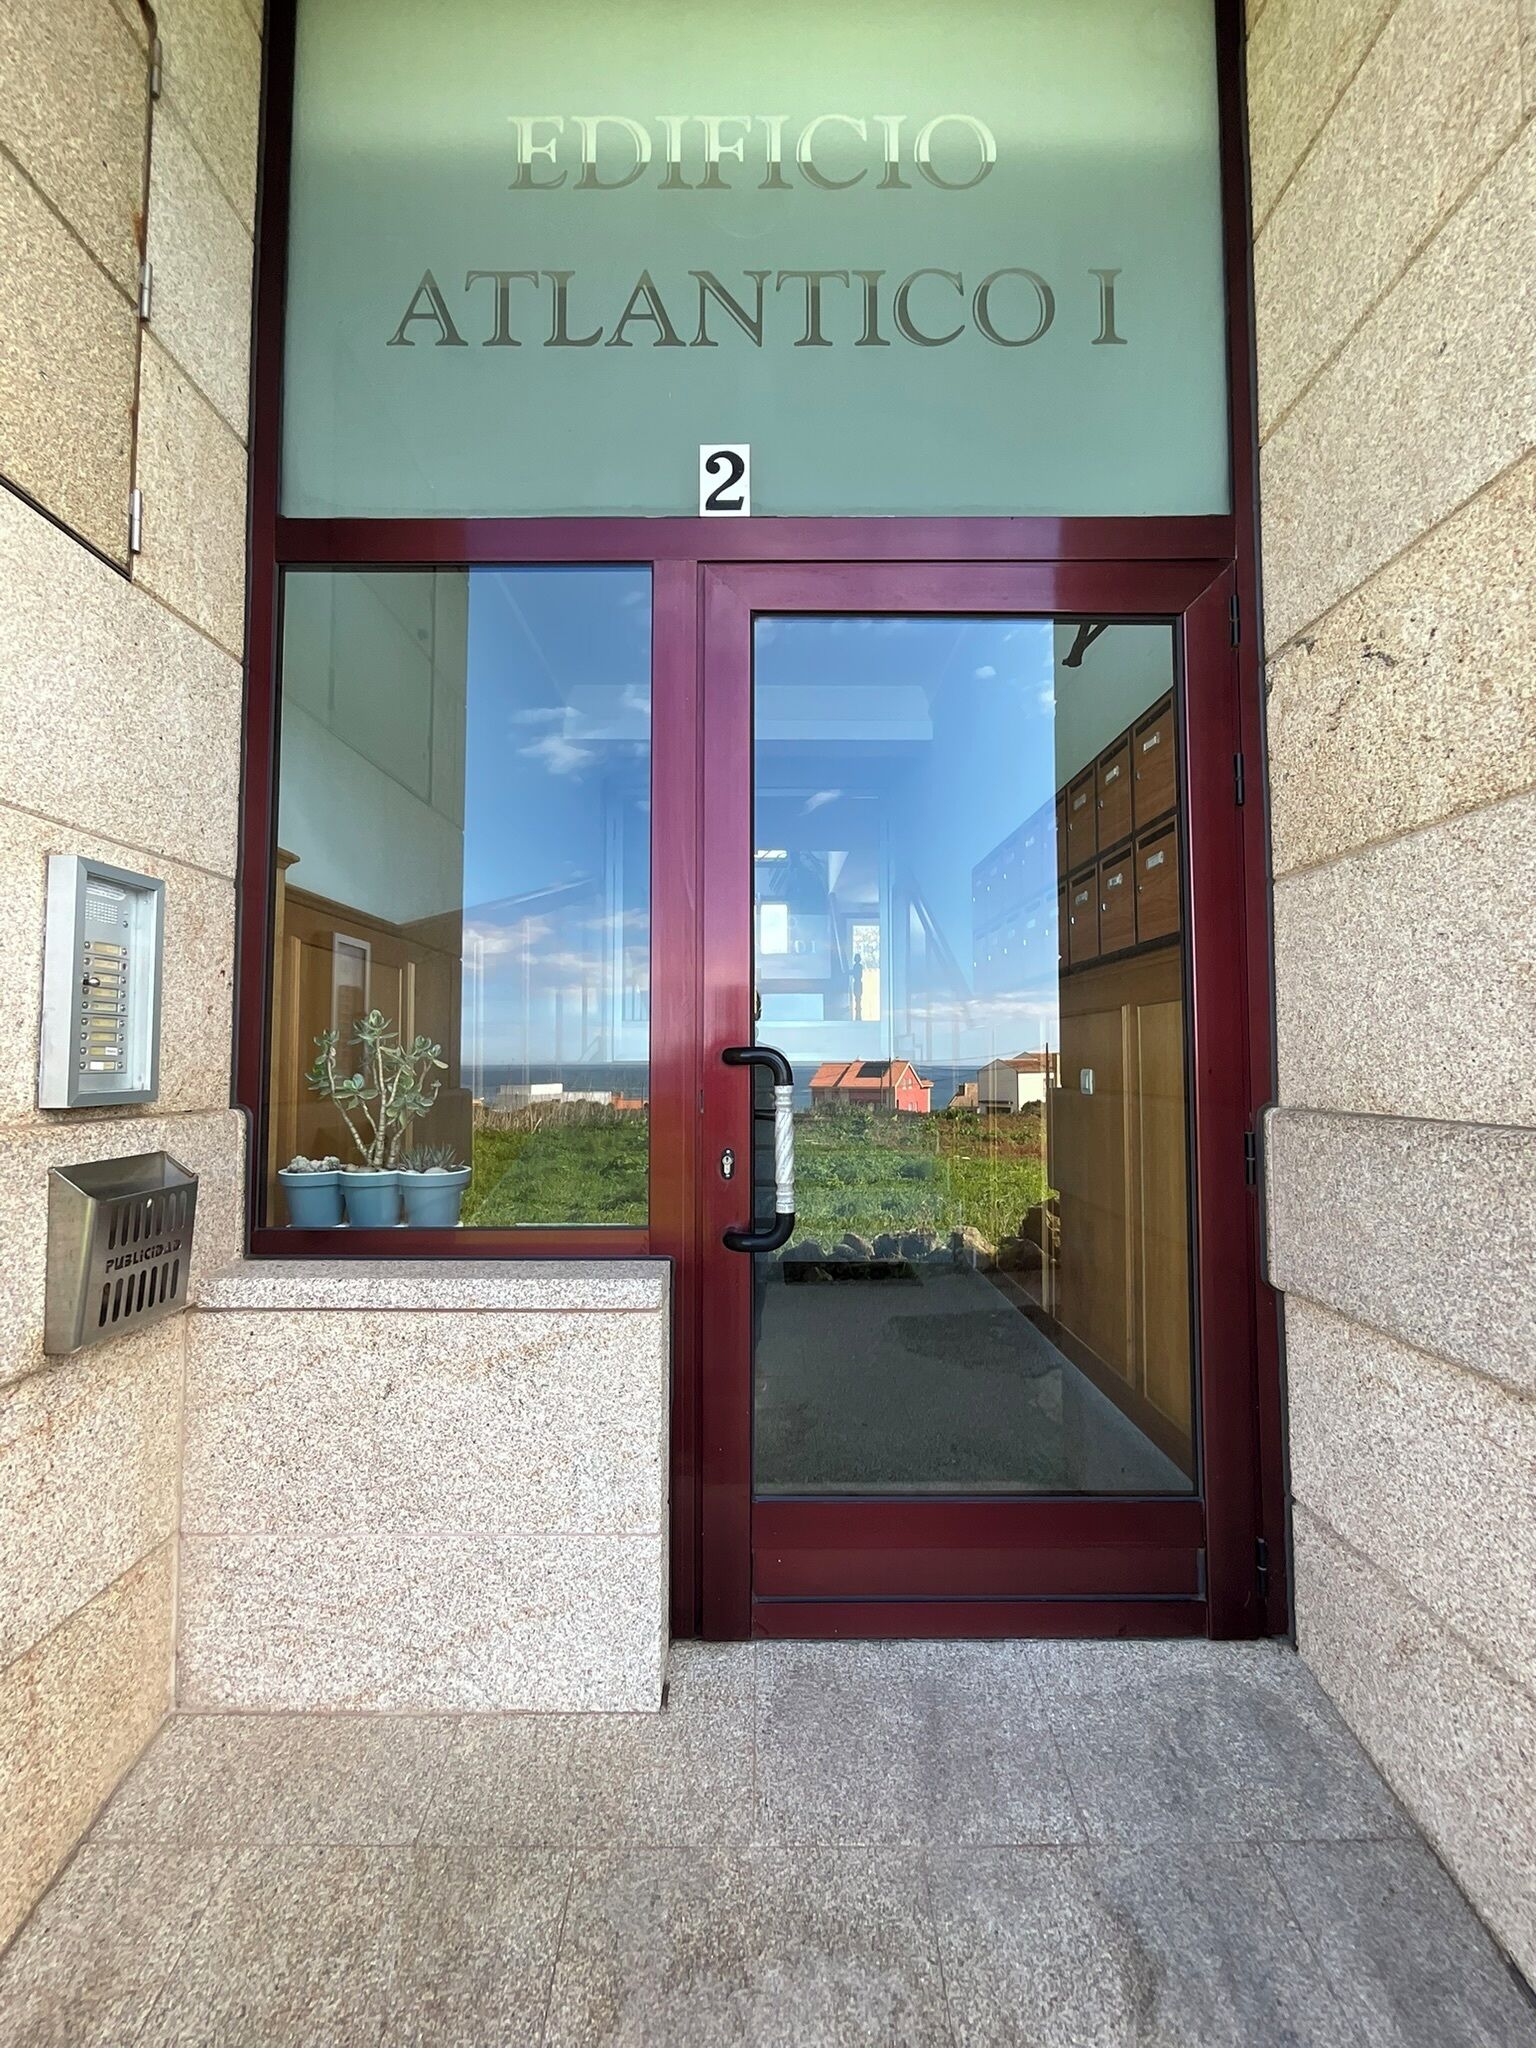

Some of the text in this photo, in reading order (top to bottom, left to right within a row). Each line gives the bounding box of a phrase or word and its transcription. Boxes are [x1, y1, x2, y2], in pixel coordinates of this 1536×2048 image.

[510, 114, 998, 190] EDIFICIO
[386, 268, 1128, 348] ATLANTICO I
[704, 450, 745, 512] 2
